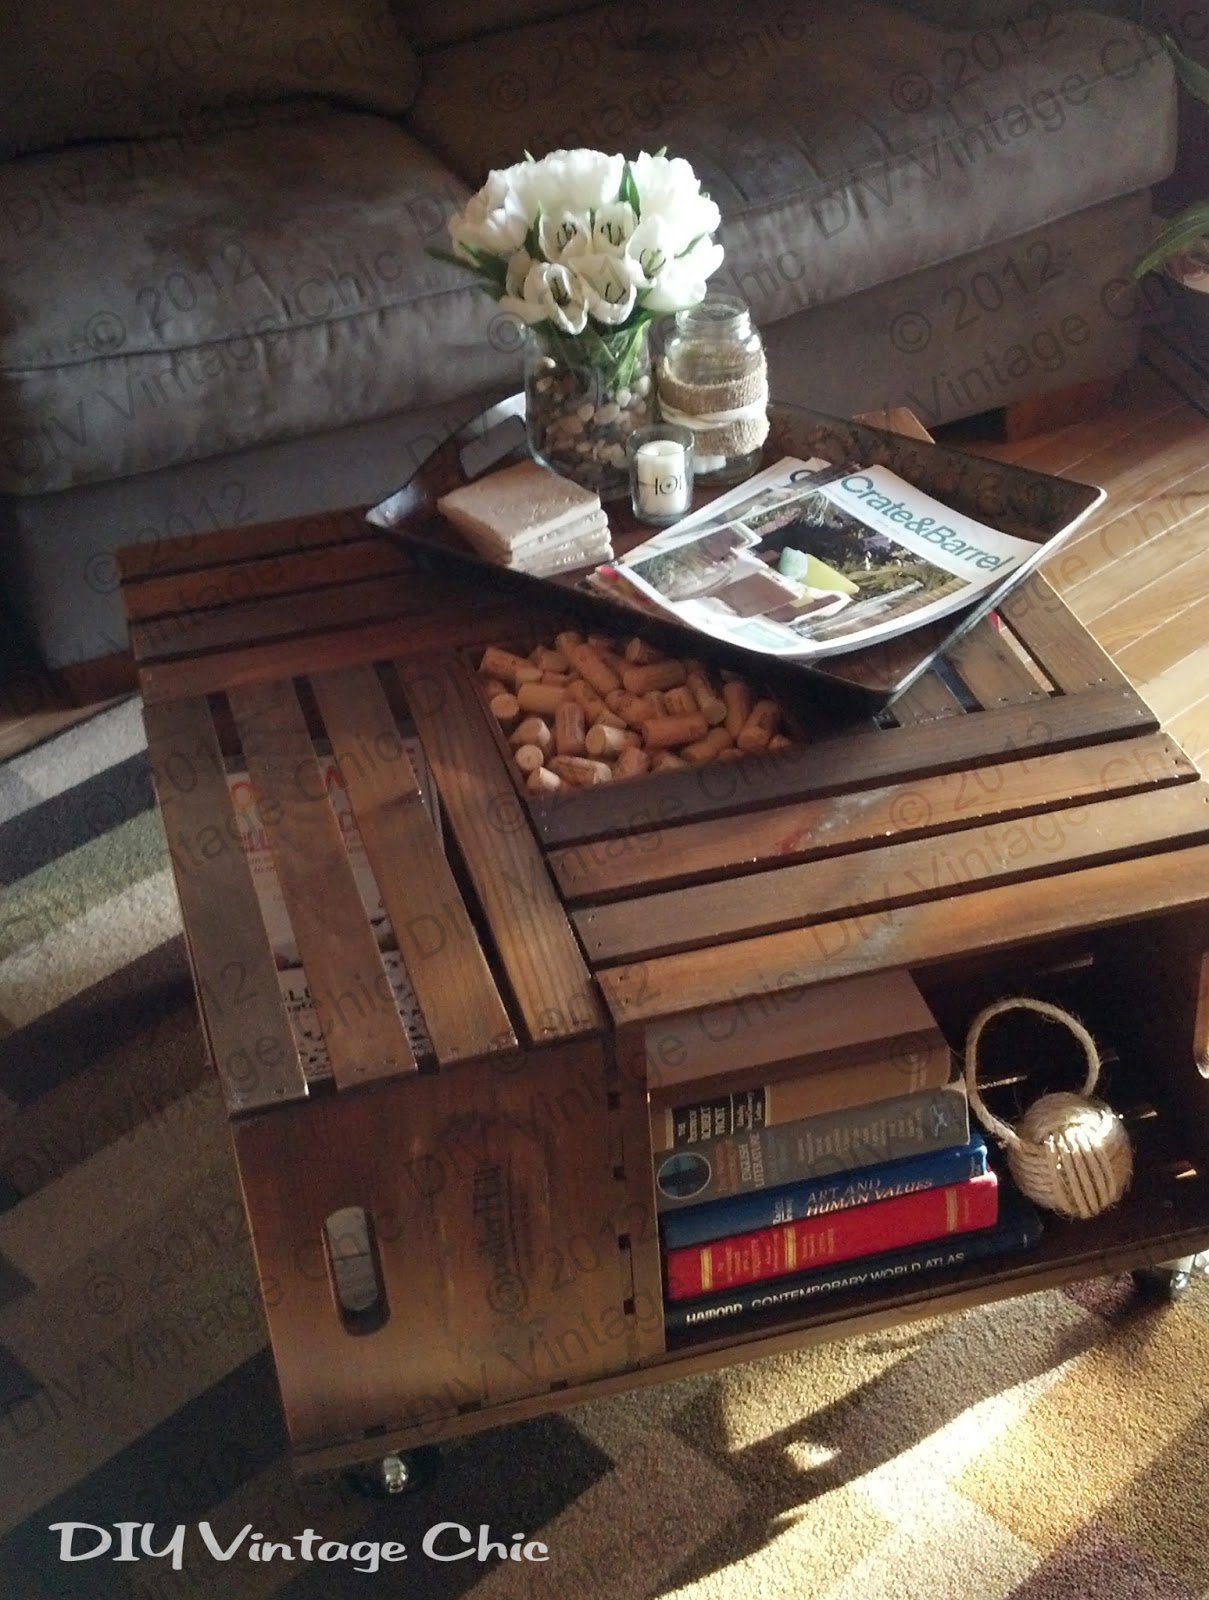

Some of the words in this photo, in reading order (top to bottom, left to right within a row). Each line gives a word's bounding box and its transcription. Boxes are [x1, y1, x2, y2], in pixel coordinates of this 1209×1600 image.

[841, 475, 1015, 572] Crate&Barrel
[806, 1193, 869, 1217] HUMAN
[875, 1181, 933, 1200] VALUES
[807, 1187, 839, 1203] ART
[844, 1178, 881, 1196] AND
[751, 1274, 867, 1308] CONTEMPORARY
[871, 1262, 921, 1281] WORLD
[925, 1252, 965, 1270] ATLAS
